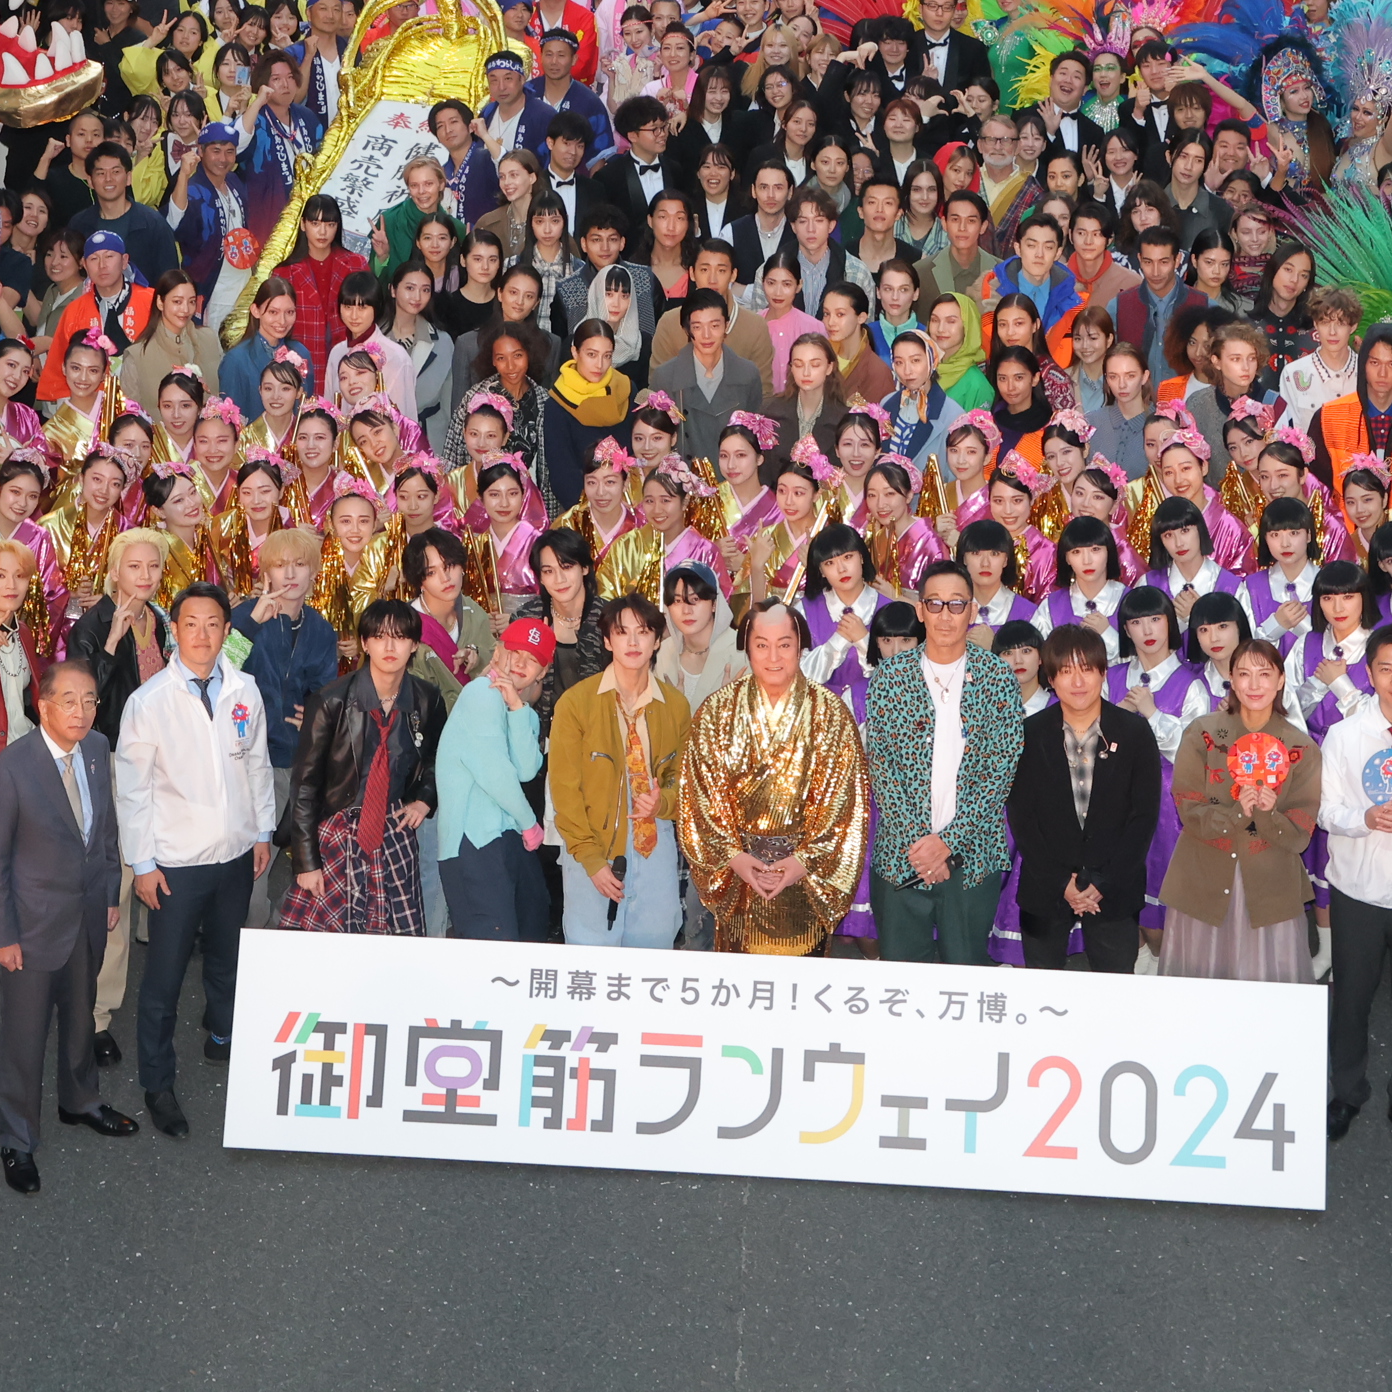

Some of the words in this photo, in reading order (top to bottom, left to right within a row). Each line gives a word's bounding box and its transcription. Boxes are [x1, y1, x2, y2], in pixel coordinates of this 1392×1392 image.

[272, 1011, 1295, 1173] 御堂筋ランウェイ2024
